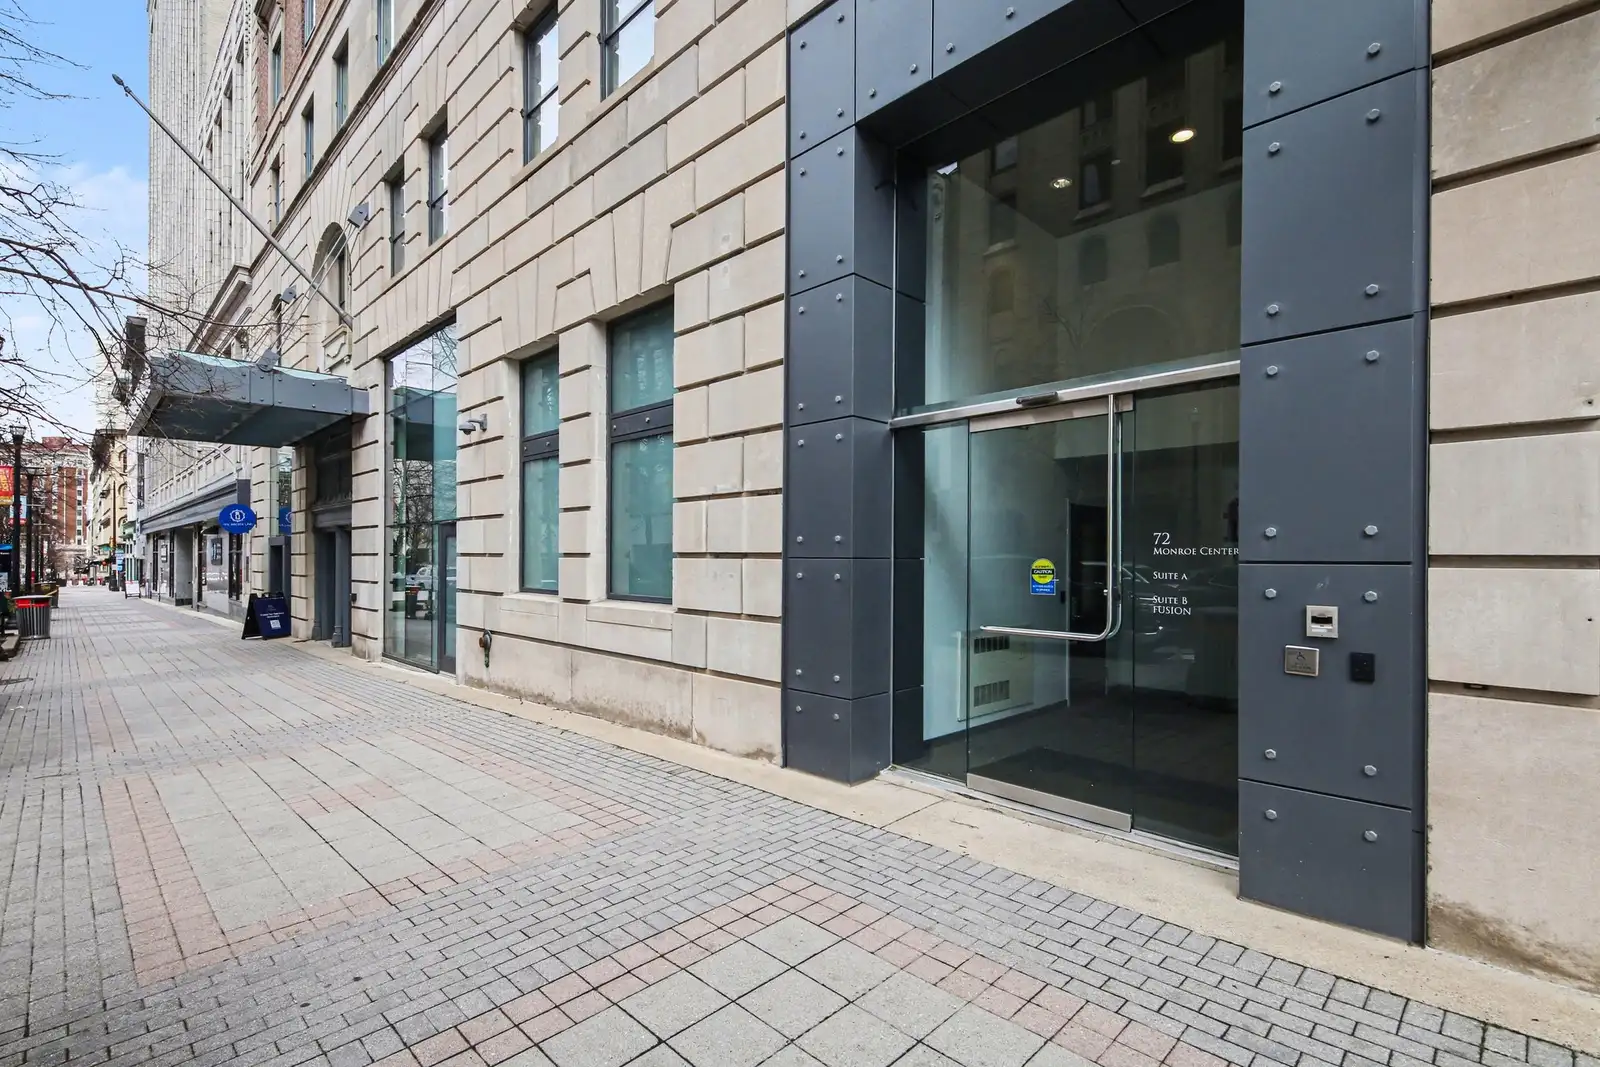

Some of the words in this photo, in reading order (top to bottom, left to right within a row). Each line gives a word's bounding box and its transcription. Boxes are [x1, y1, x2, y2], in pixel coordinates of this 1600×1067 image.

[1153, 532, 1171, 545] 72
[1153, 547, 1197, 556] MONROE
[1200, 546, 1239, 556] CENTER
[1153, 571, 1179, 580] SUITE
[1153, 595, 1179, 605] SUITE
[1182, 596, 1188, 605] B
[1153, 606, 1192, 616] FUSION
